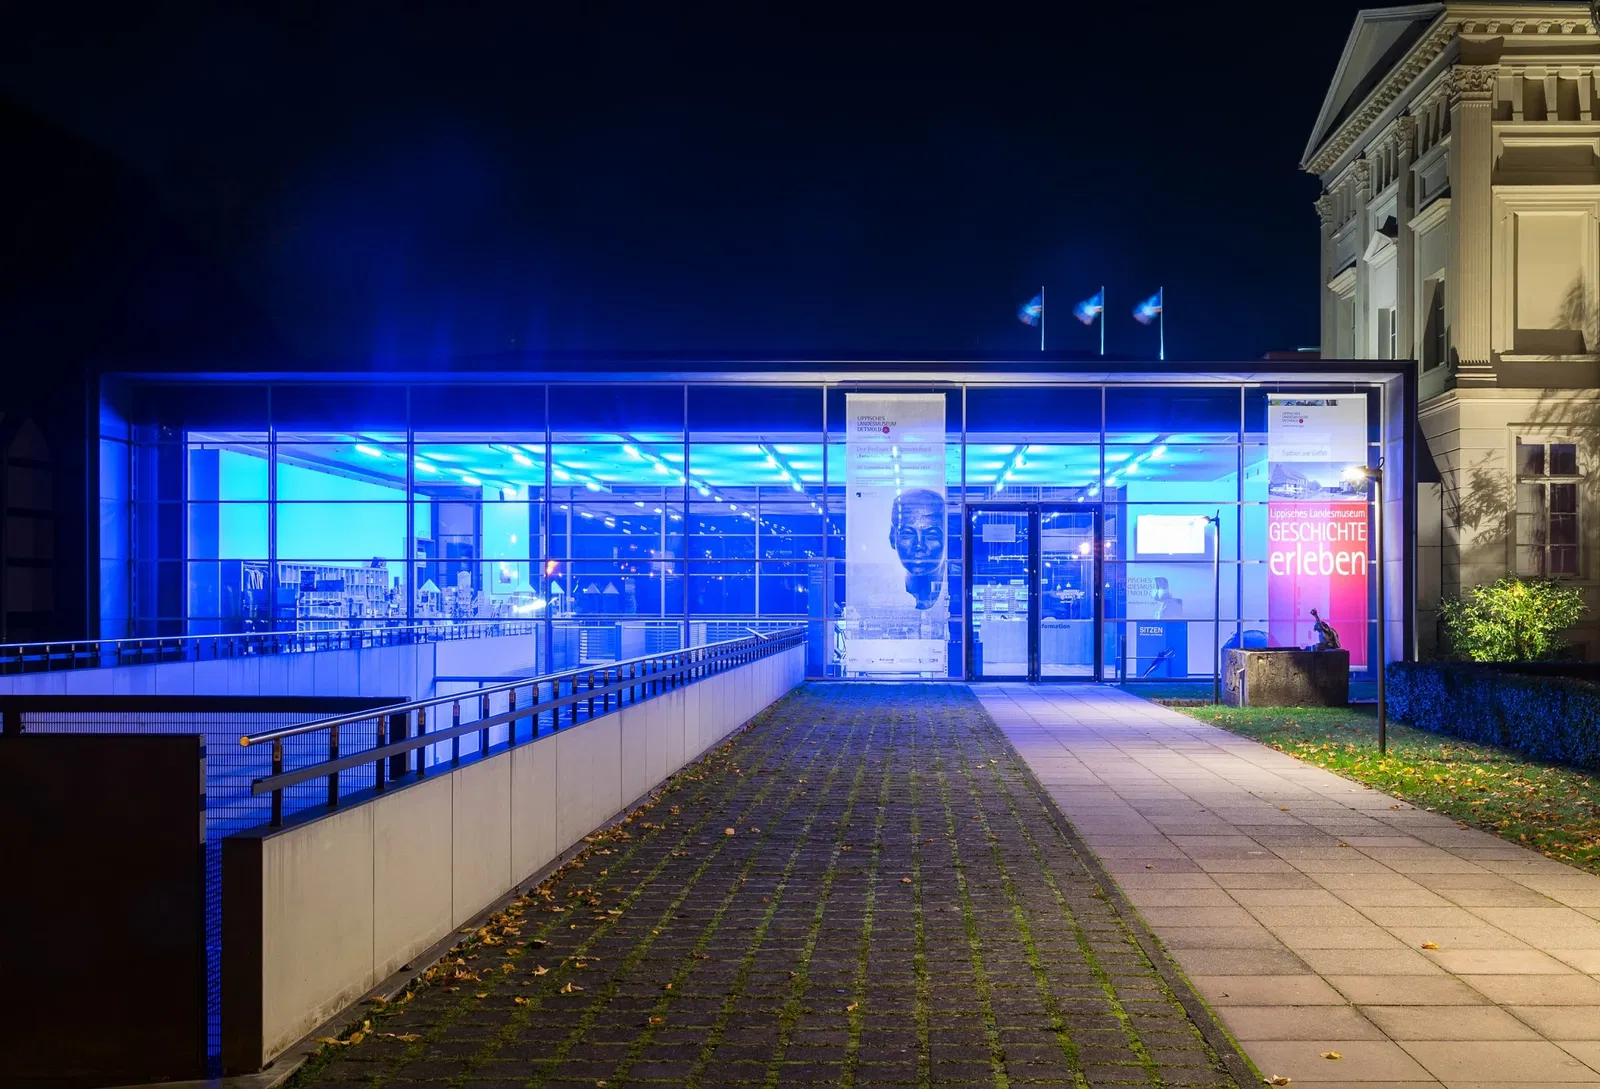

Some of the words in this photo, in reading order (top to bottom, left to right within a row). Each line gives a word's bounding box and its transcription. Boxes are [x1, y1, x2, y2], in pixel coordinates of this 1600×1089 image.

[1270, 508, 1308, 520] Lippisches
[1309, 508, 1366, 518] Landesmuseum
[1269, 521, 1367, 542] GESCHICHTE
[1269, 542, 1366, 576] erleben
[1041, 622, 1071, 630] formation
[1139, 626, 1163, 634] SITZEN
